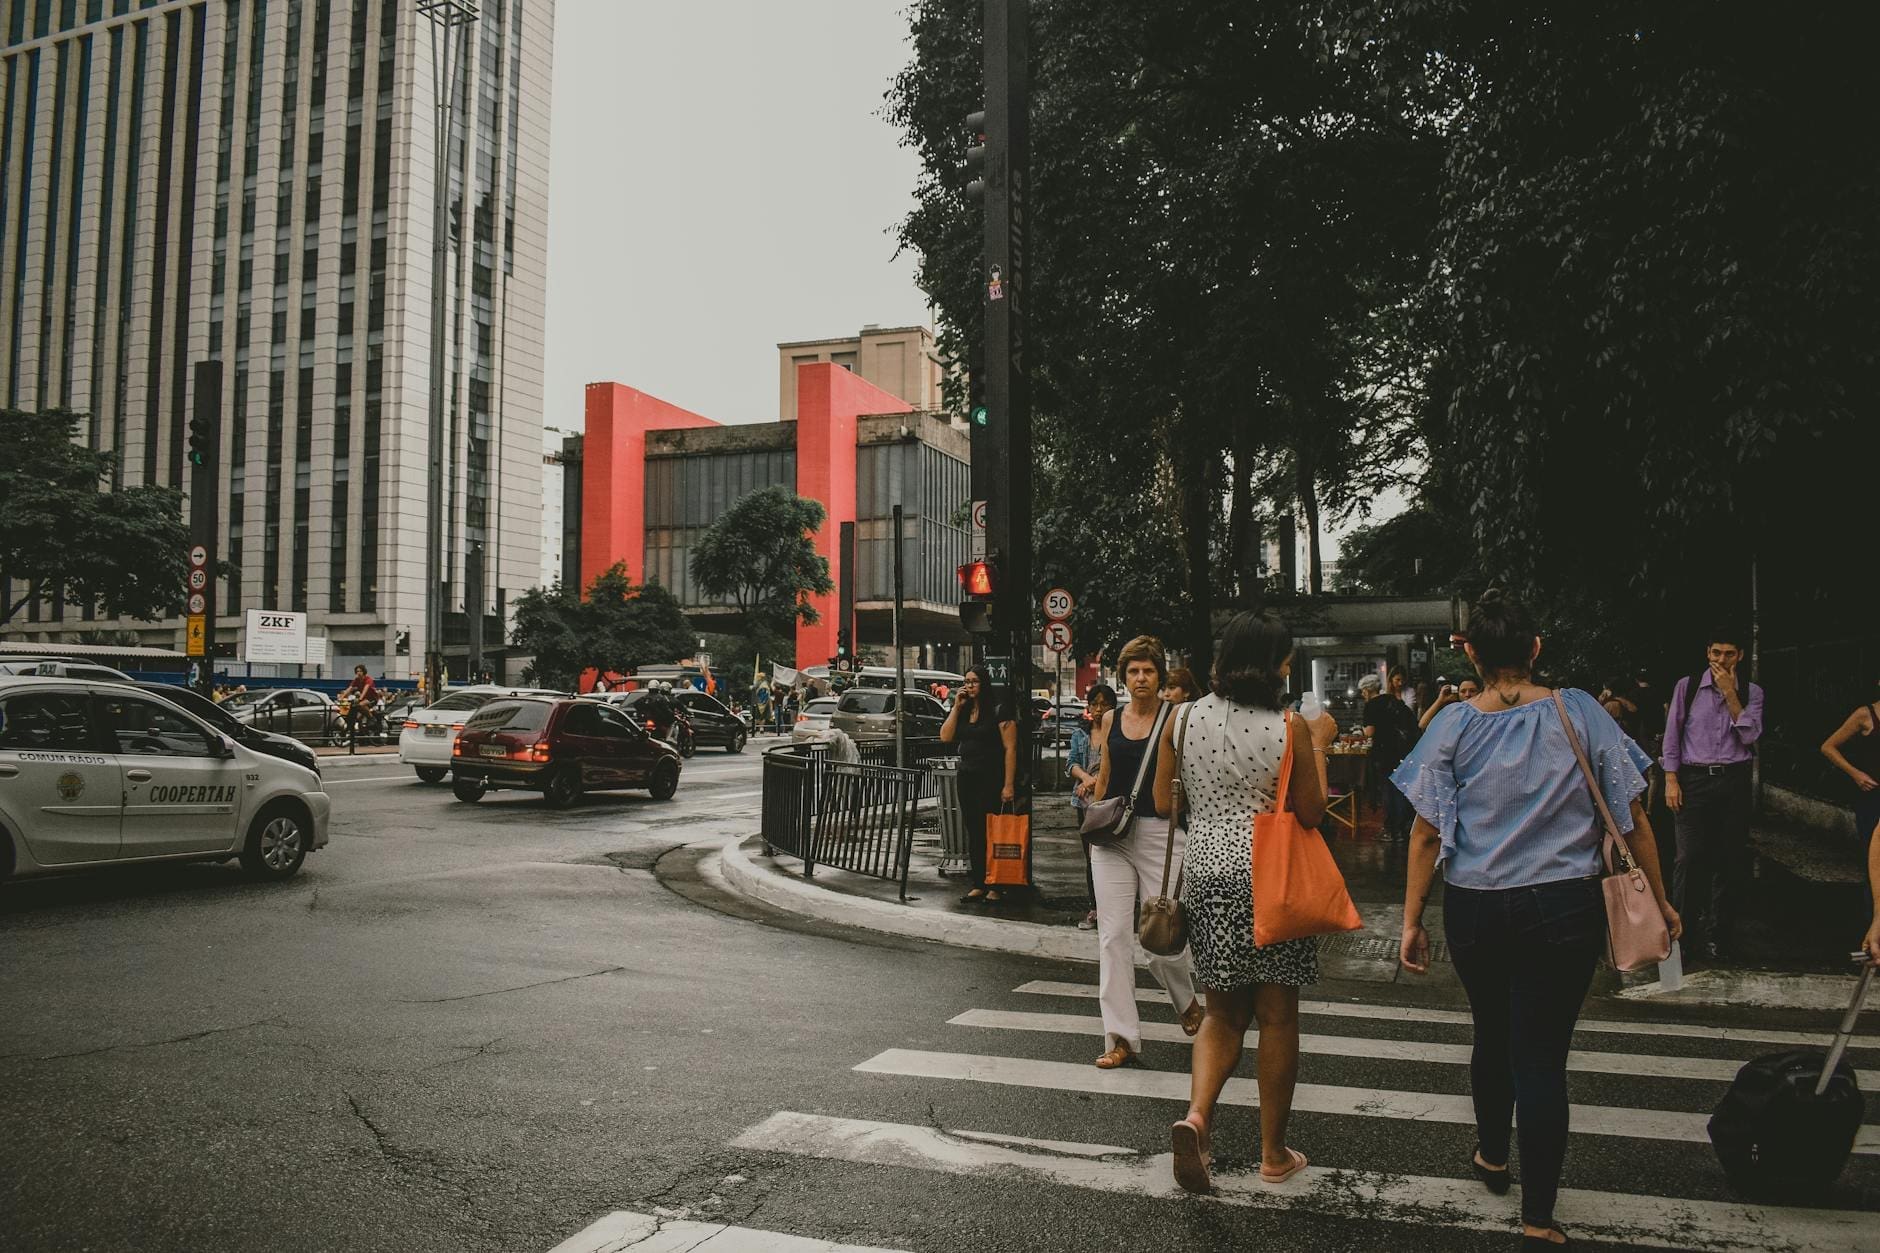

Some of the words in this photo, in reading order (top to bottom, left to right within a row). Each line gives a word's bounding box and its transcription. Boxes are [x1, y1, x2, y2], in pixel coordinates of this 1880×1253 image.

[1011, 169, 1023, 315] Paulista
[193, 573, 204, 584] 50
[1049, 596, 1068, 609] 50
[261, 616, 294, 628] ZKF
[39, 664, 57, 675] TAXI
[18, 752, 66, 762] COMUM
[150, 785, 236, 803] COOPERTAX
